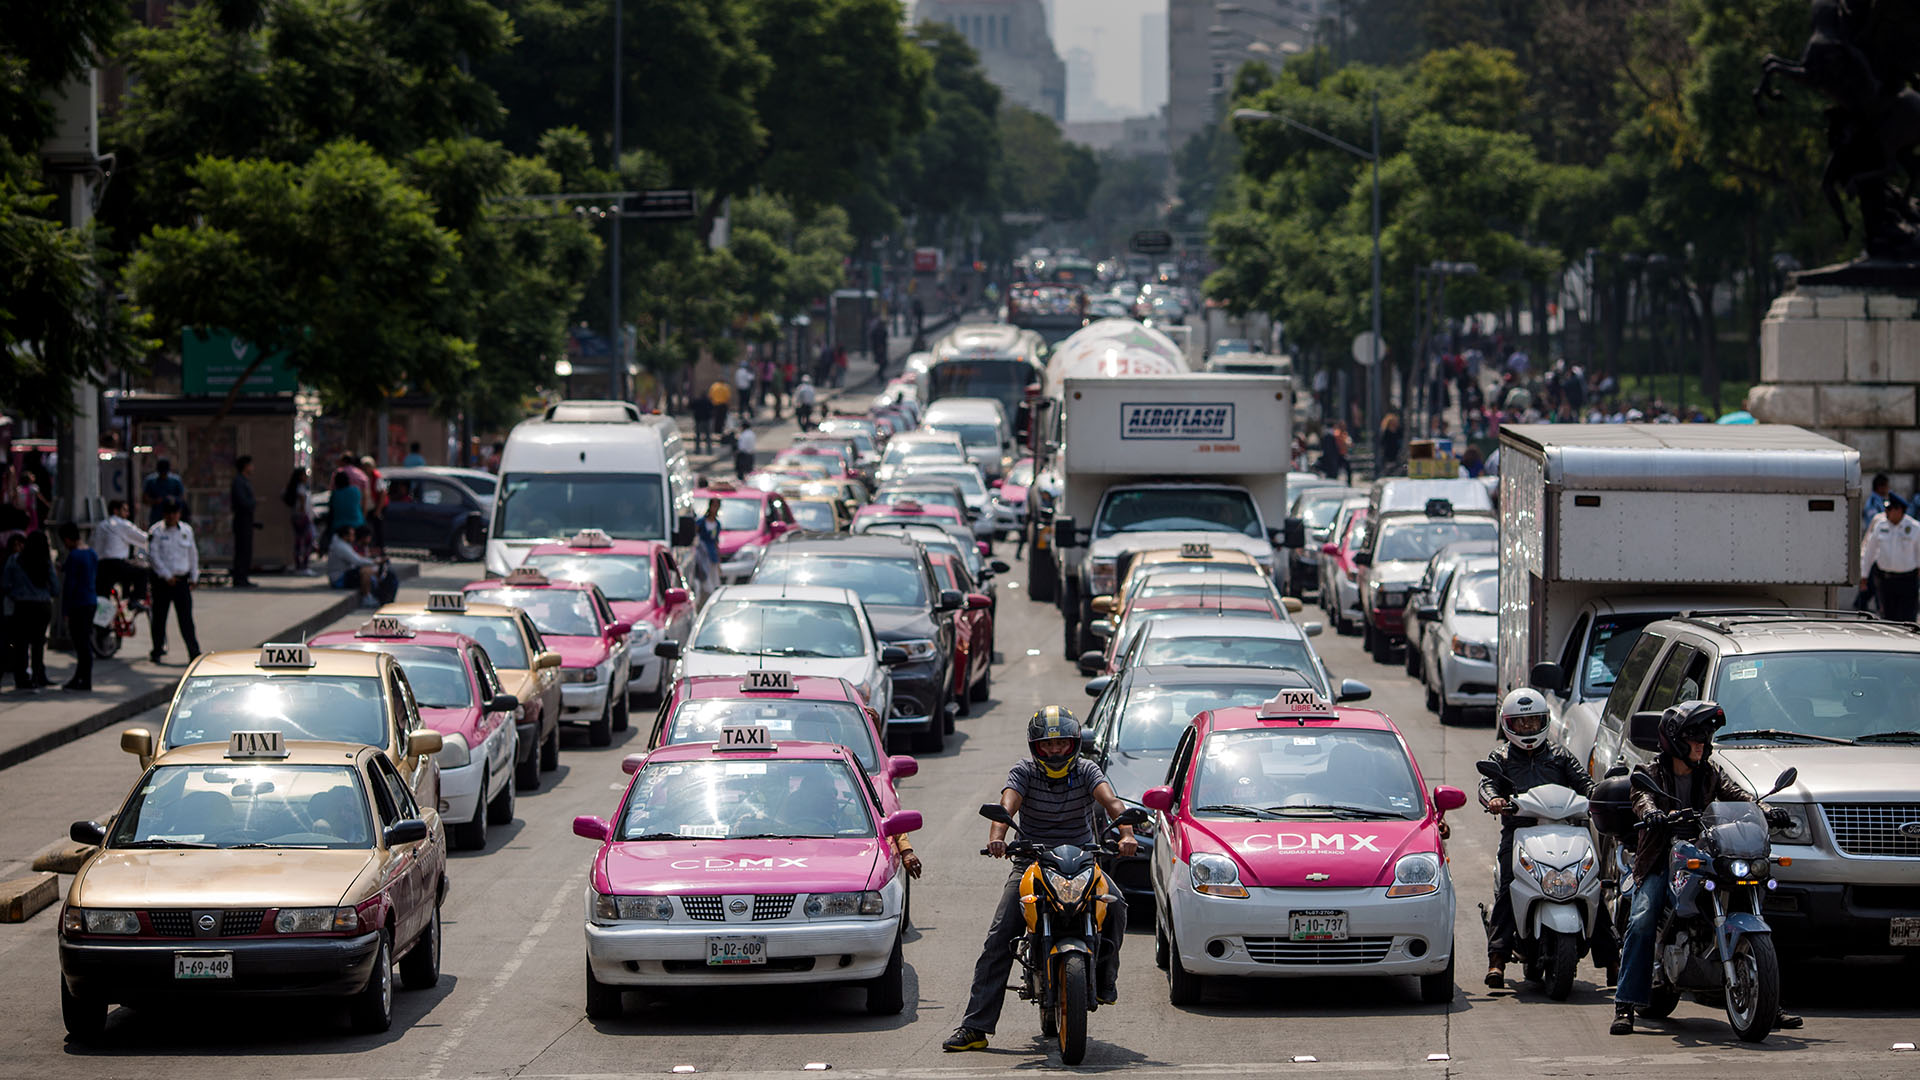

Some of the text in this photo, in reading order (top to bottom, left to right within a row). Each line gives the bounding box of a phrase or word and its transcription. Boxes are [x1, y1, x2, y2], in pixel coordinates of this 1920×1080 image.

[1128, 408, 1227, 427] AEROFLASH
[515, 567, 538, 577] TAXI
[372, 618, 398, 630] TAXI
[265, 649, 303, 663] TAXI
[750, 673, 788, 687] TAXI
[1282, 693, 1313, 704] TAXI
[1291, 704, 1312, 712] LIBRE
[233, 733, 277, 752] TAXI
[723, 729, 764, 744] TAXI
[1243, 833, 1381, 853] CDMX
[670, 857, 809, 870] CDMX
[1294, 918, 1343, 932] A-10-737
[711, 943, 761, 956] B-02-609
[179, 961, 229, 974] A-69-449
